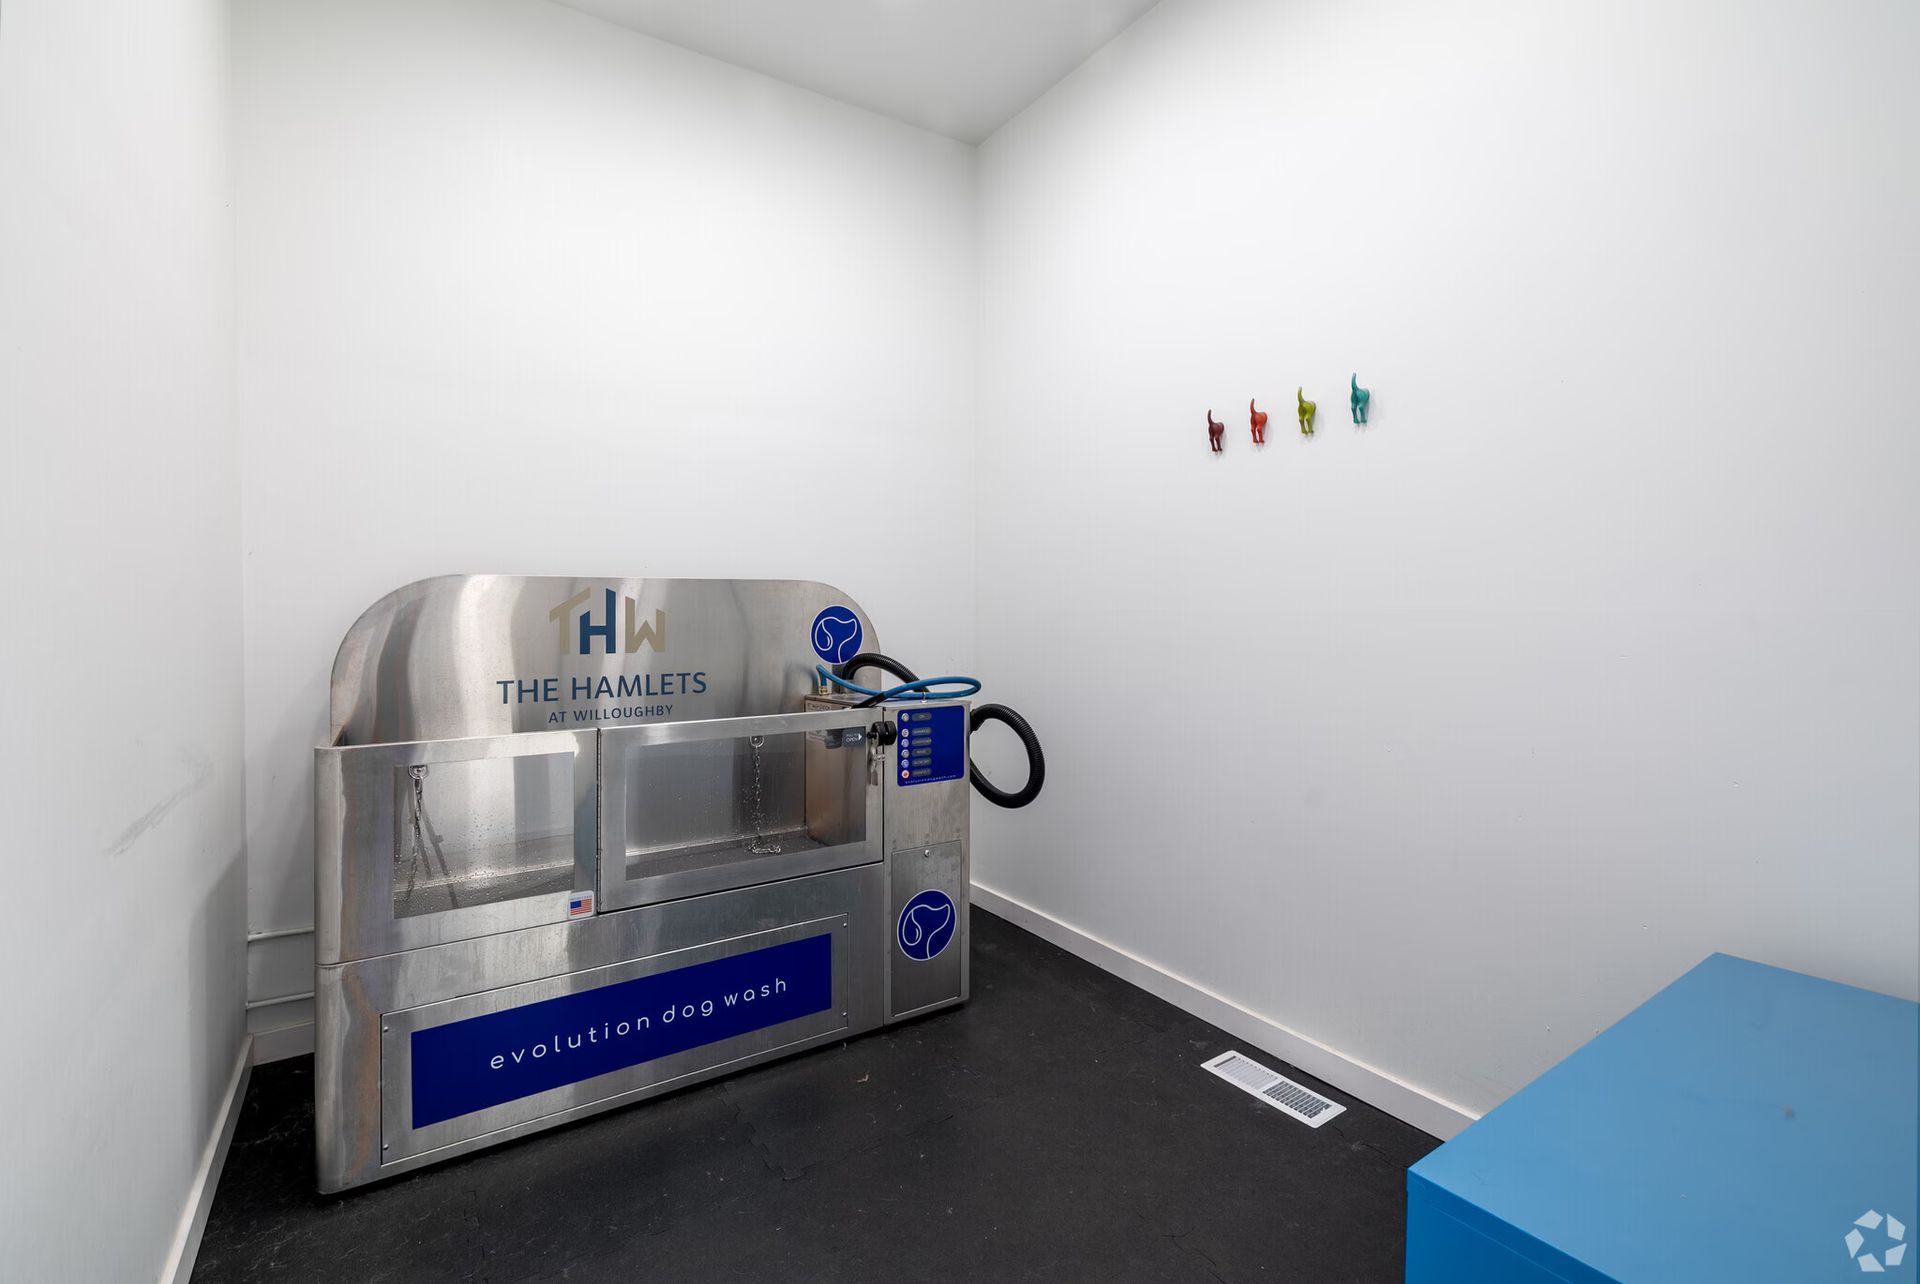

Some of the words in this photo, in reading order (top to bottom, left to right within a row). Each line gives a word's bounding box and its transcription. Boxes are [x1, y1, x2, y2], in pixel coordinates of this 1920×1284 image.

[549, 586, 666, 655] THW
[496, 678, 559, 704] THE
[572, 672, 707, 700] HAMLETS
[548, 711, 567, 723] AT
[573, 705, 673, 721] WILLOUGHBY
[490, 1015, 650, 1070] evolution
[662, 999, 714, 1023] dog
[724, 977, 787, 1007] wash
